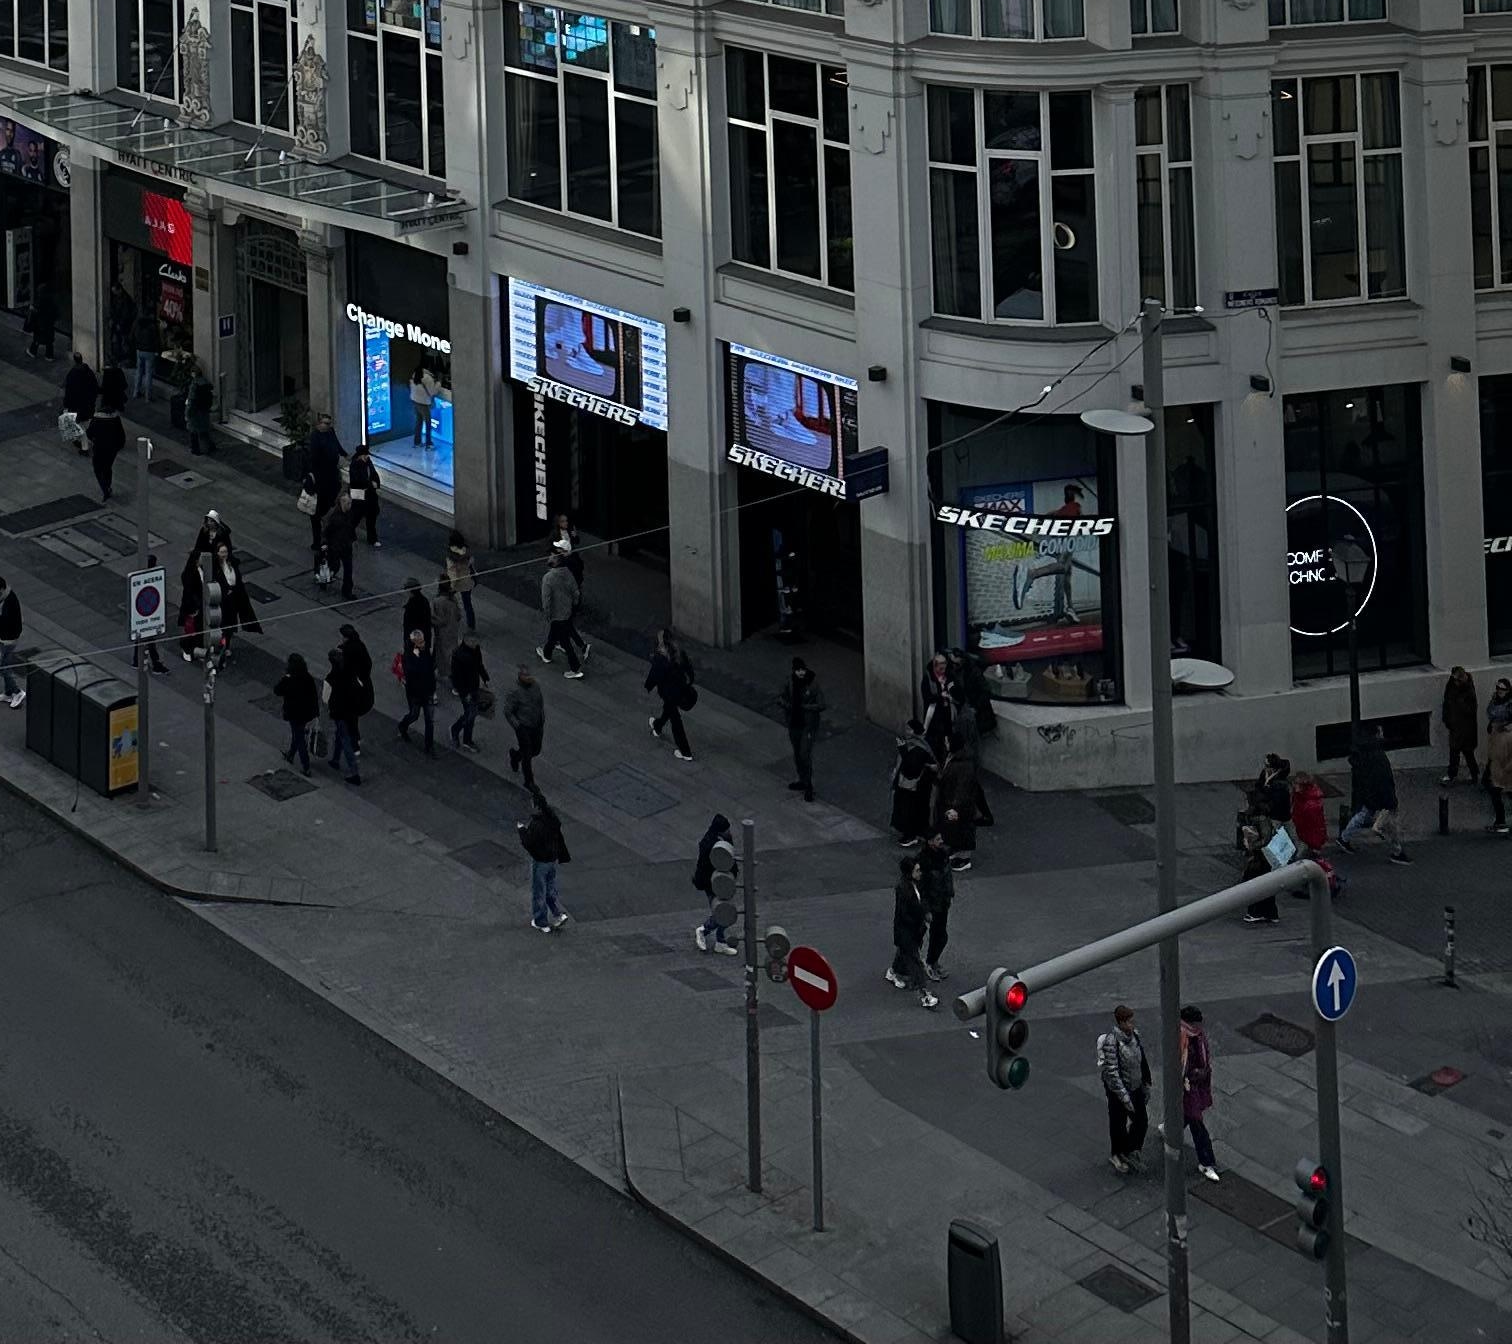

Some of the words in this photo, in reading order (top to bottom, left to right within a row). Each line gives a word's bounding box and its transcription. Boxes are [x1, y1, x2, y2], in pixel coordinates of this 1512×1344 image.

[118, 150, 147, 169] HYATT
[150, 160, 197, 185] CENTRIC
[159, 263, 188, 283] Clarks
[346, 303, 405, 339] Change
[406, 323, 452, 354] Mone
[526, 375, 643, 427] SKECHERS
[533, 393, 548, 521] SKECHERS
[936, 505, 1116, 537] SKECHERS
